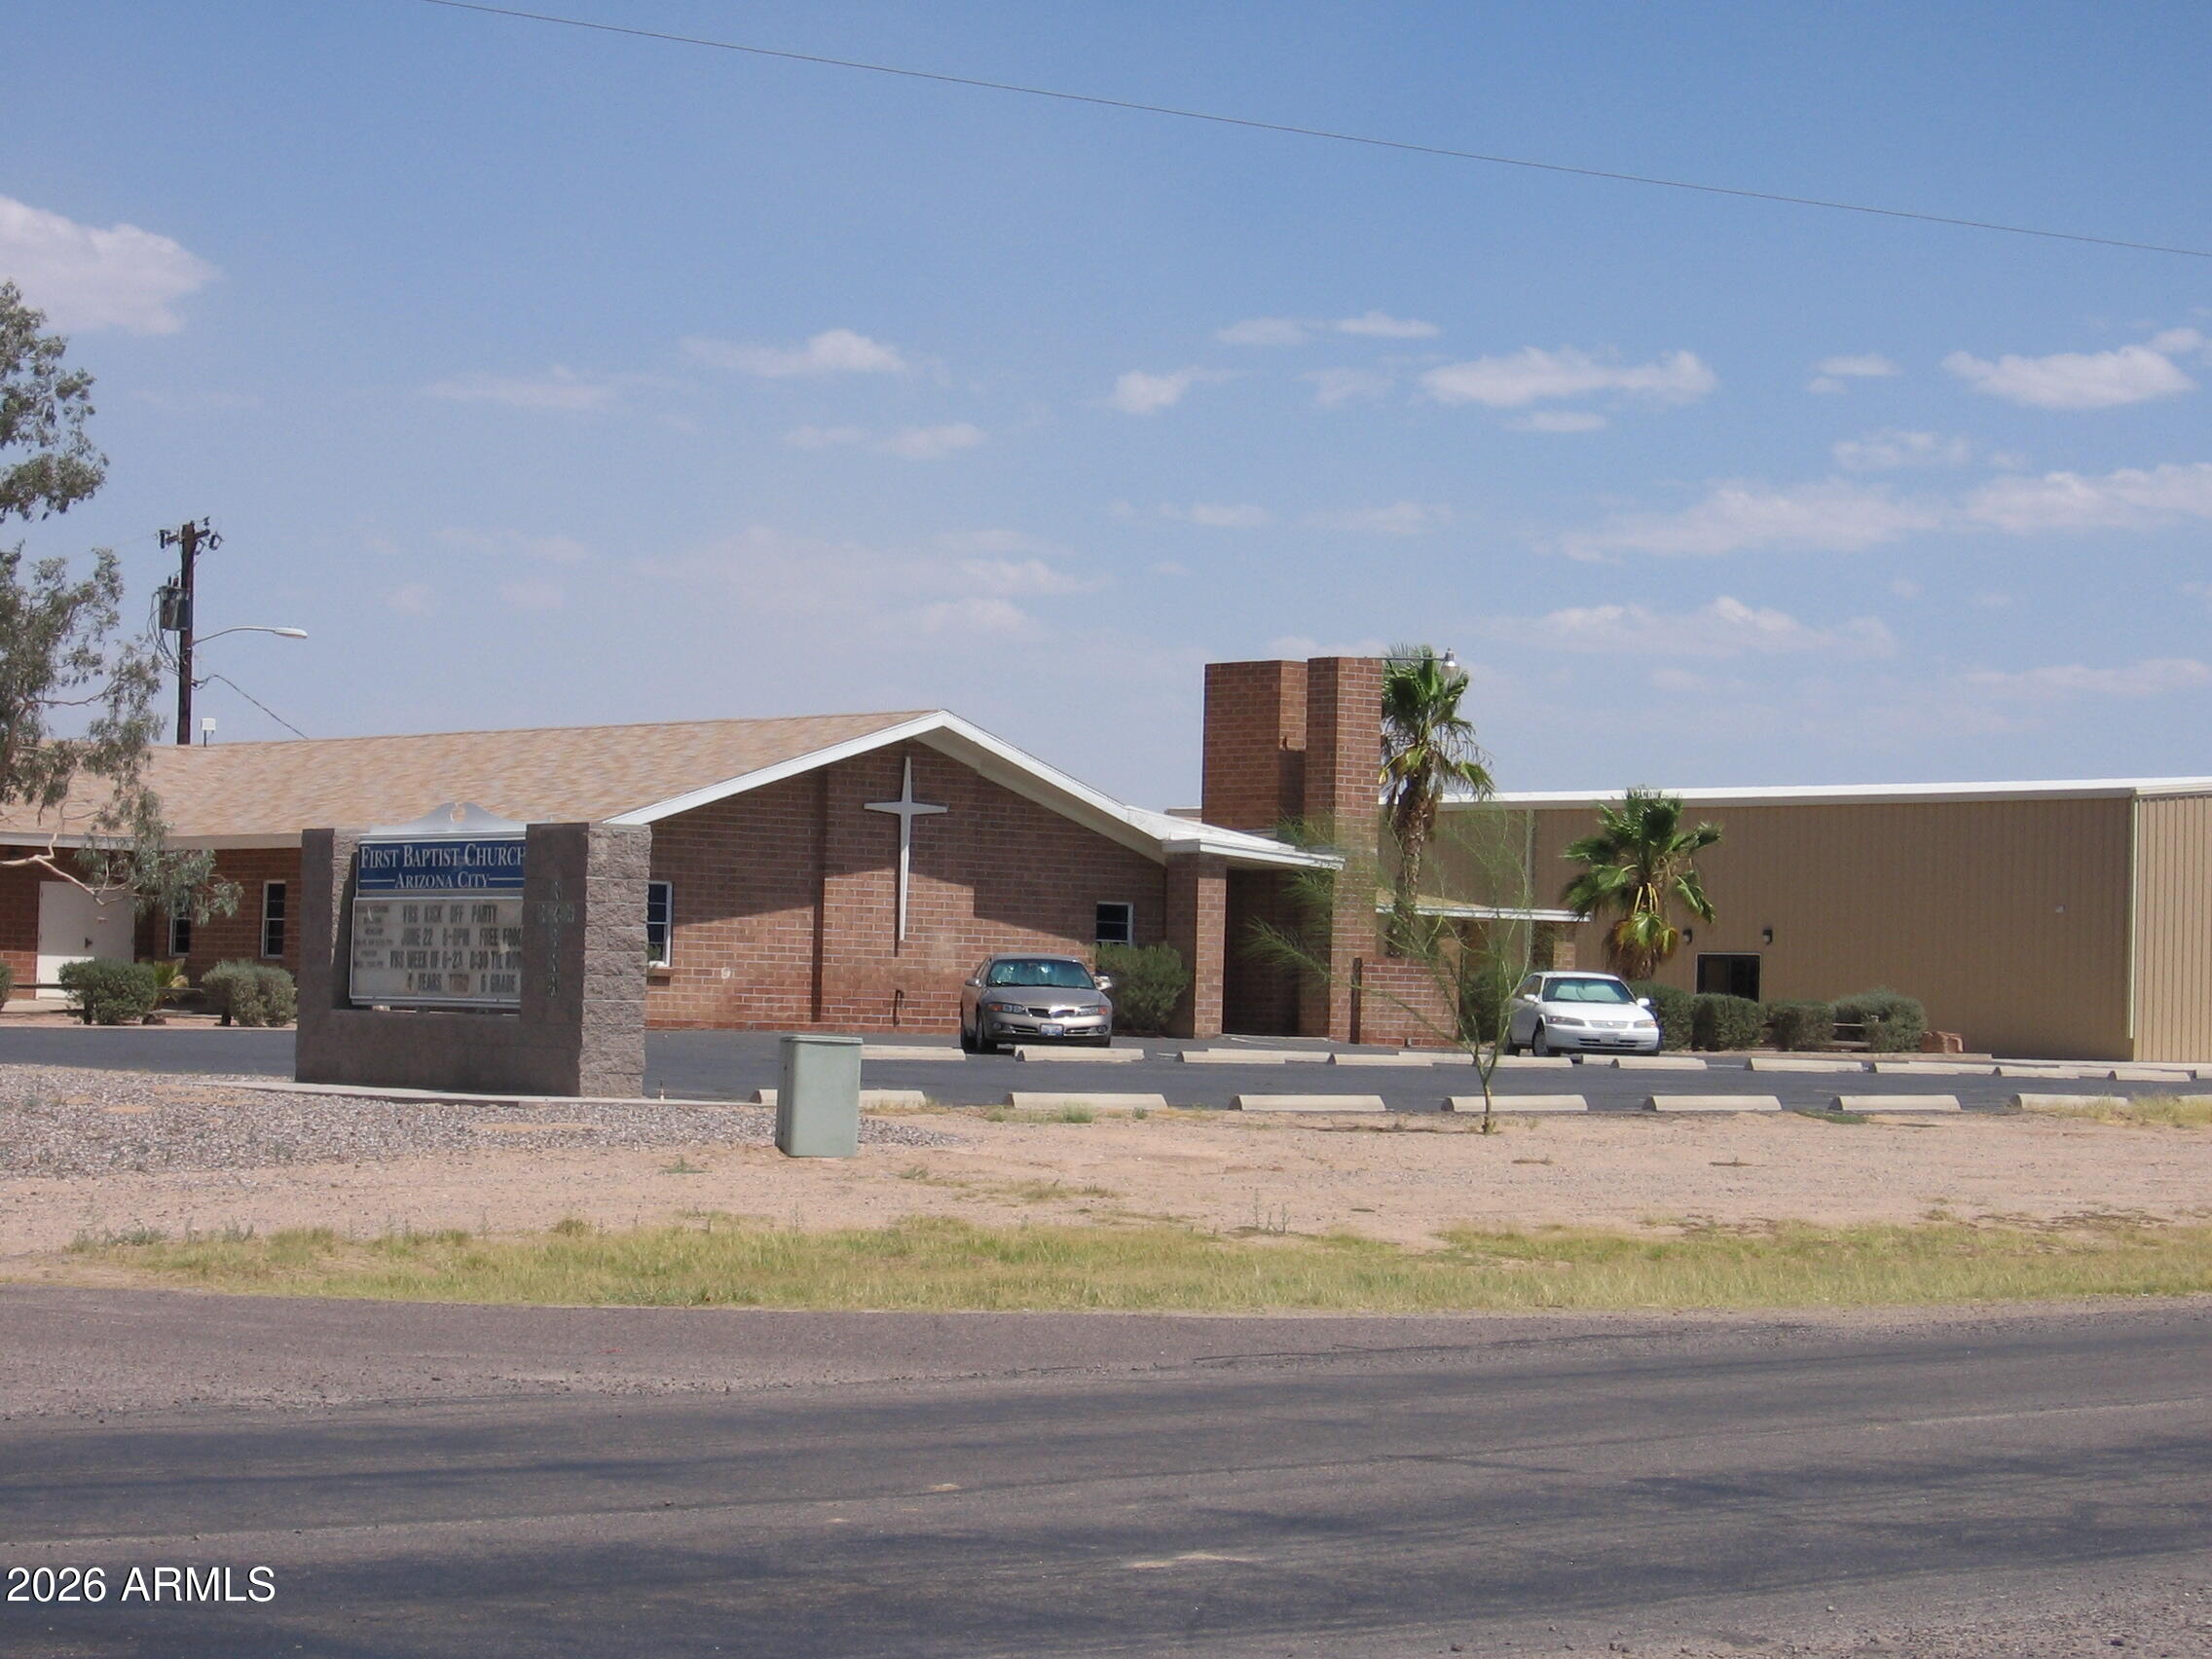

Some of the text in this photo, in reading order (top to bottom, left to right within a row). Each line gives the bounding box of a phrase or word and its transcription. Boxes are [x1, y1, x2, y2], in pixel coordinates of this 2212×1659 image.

[360, 843, 526, 868] FIRST BAPTIST CHURCH
[394, 871, 490, 889] ARIZONA CITY
[450, 904, 463, 923] OFF
[471, 904, 498, 923] PARTY
[479, 928, 498, 946] FREE
[407, 950, 427, 970] WEEK
